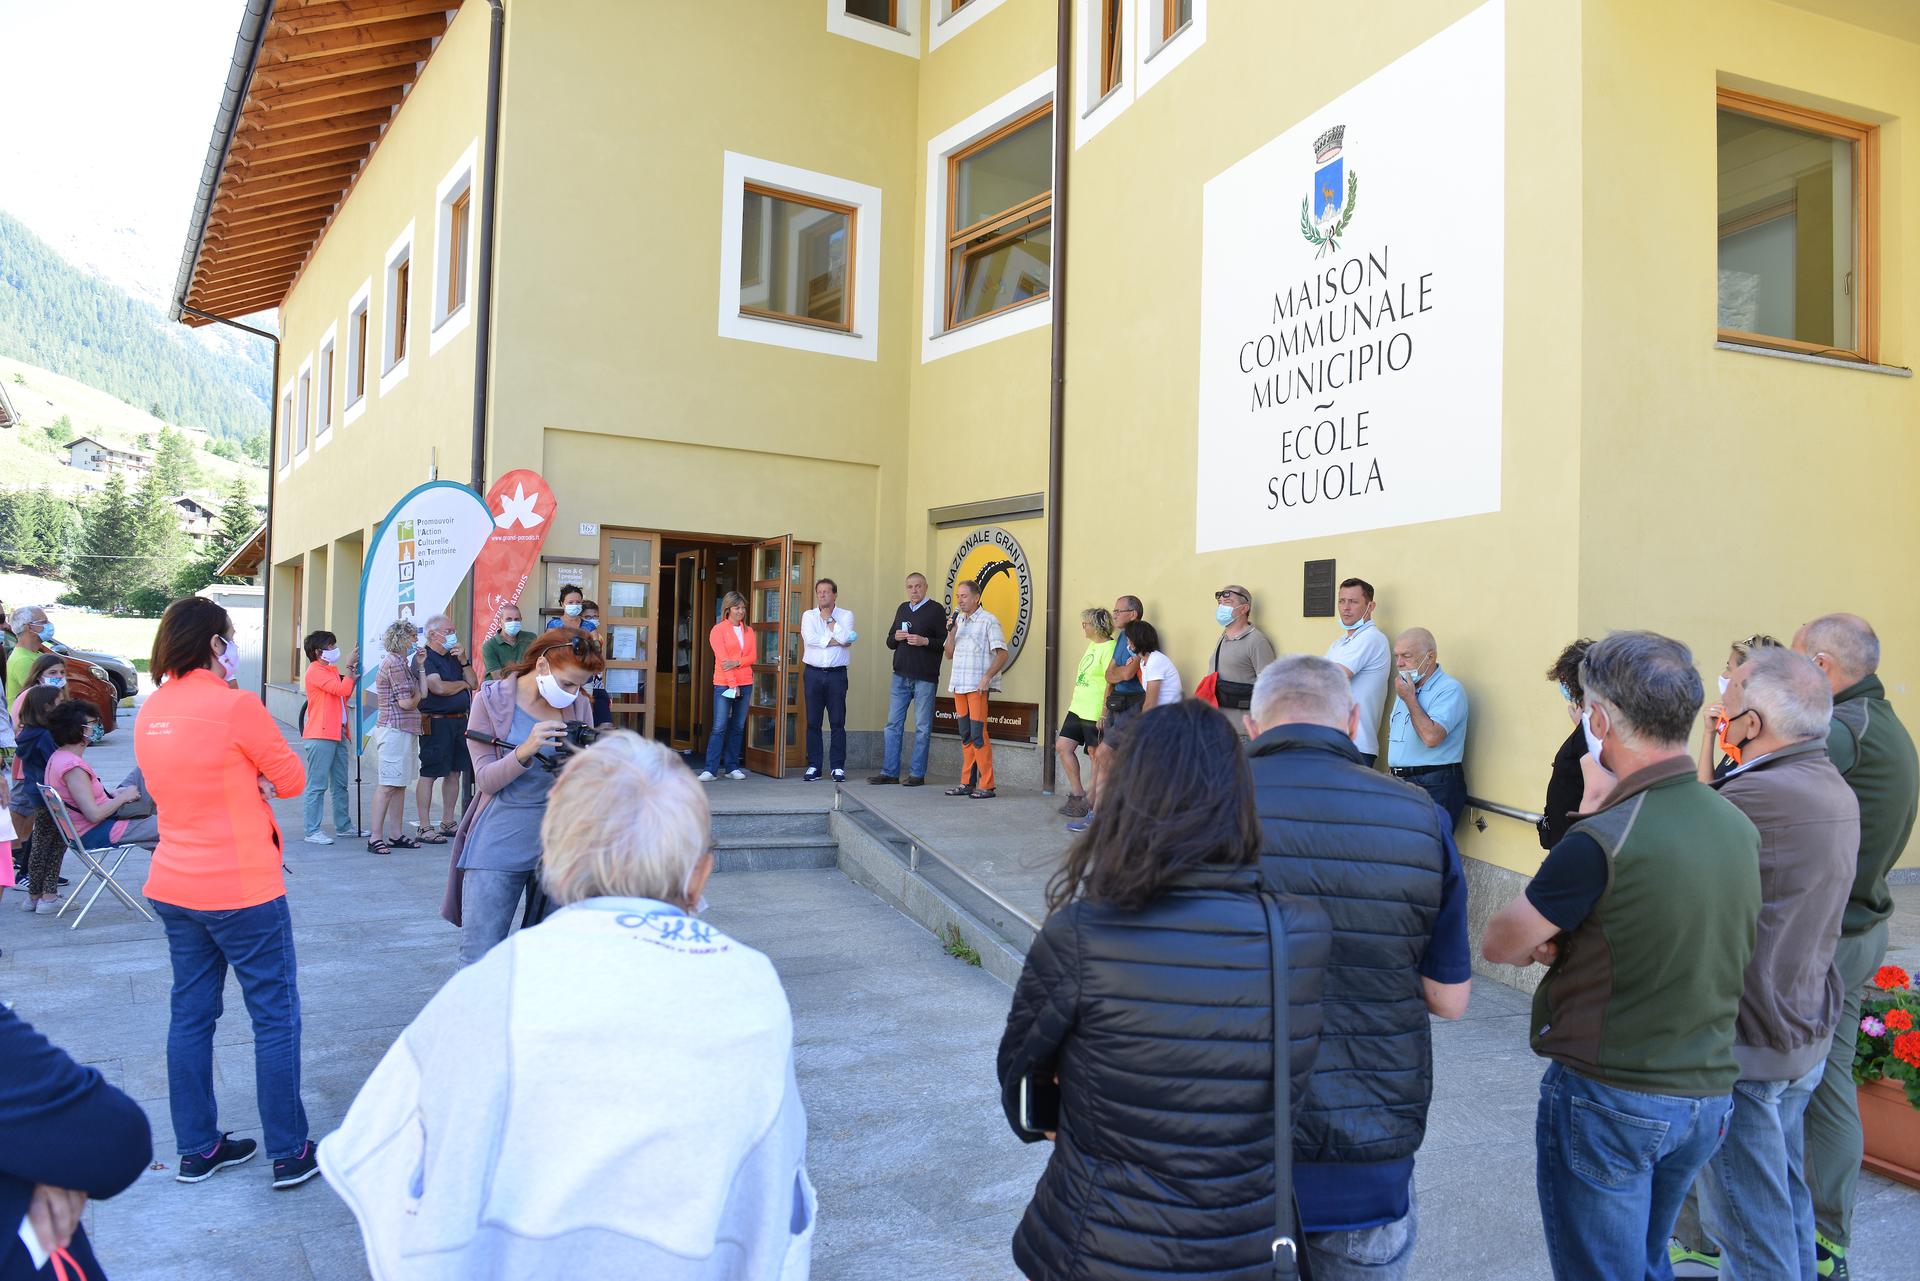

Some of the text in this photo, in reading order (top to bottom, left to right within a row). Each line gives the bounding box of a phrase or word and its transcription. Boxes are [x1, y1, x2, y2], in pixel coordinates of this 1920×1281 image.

[1272, 245, 1388, 325] MAISON
[1239, 272, 1433, 374] COMMUNALE
[1251, 332, 1413, 413] MUNICIPIO
[1282, 410, 1369, 464] ECOLE
[1267, 457, 1385, 510] SCUOLA
[416, 517, 455, 526] Promouvoir
[417, 528, 442, 537] l'Action
[417, 537, 449, 547] Culturelle
[417, 546, 457, 557] en Territoire
[417, 558, 435, 568] Alpin
[510, 574, 529, 606] ARADIS
[947, 530, 1029, 648] NAZIONALE GRAN PARADISO
[483, 598, 509, 644] ONDATION
[935, 710, 953, 720] Centro
[998, 715, 1022, 726] d'accueil
